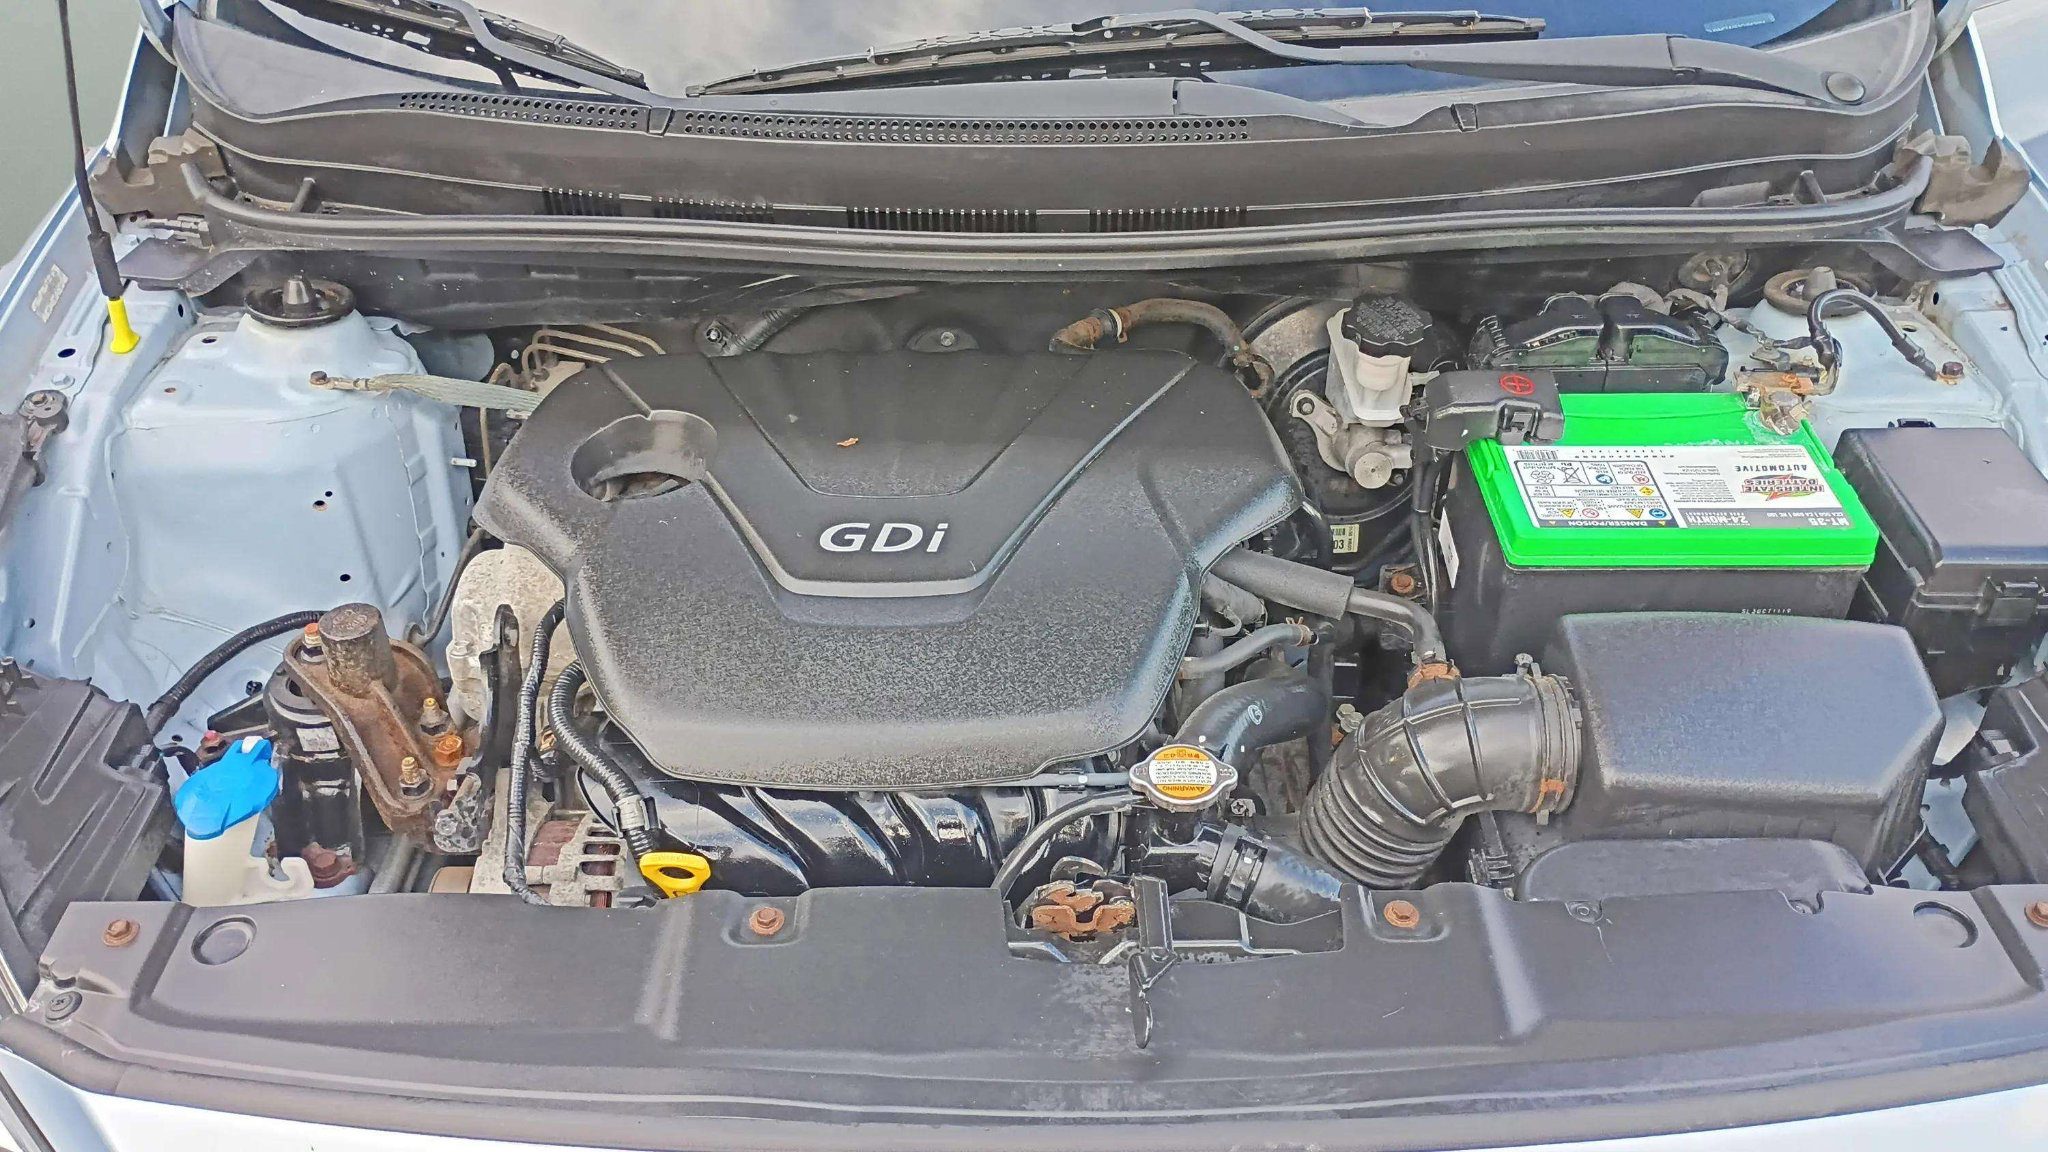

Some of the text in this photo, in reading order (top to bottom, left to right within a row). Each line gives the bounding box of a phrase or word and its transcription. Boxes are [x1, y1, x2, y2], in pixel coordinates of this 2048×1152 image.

[1734, 464, 1807, 472] AUTOMOTIVE
[1741, 485, 1824, 493] INTERSTATE
[1686, 515, 1748, 524] 24-MONTH
[819, 522, 949, 553] GDi
